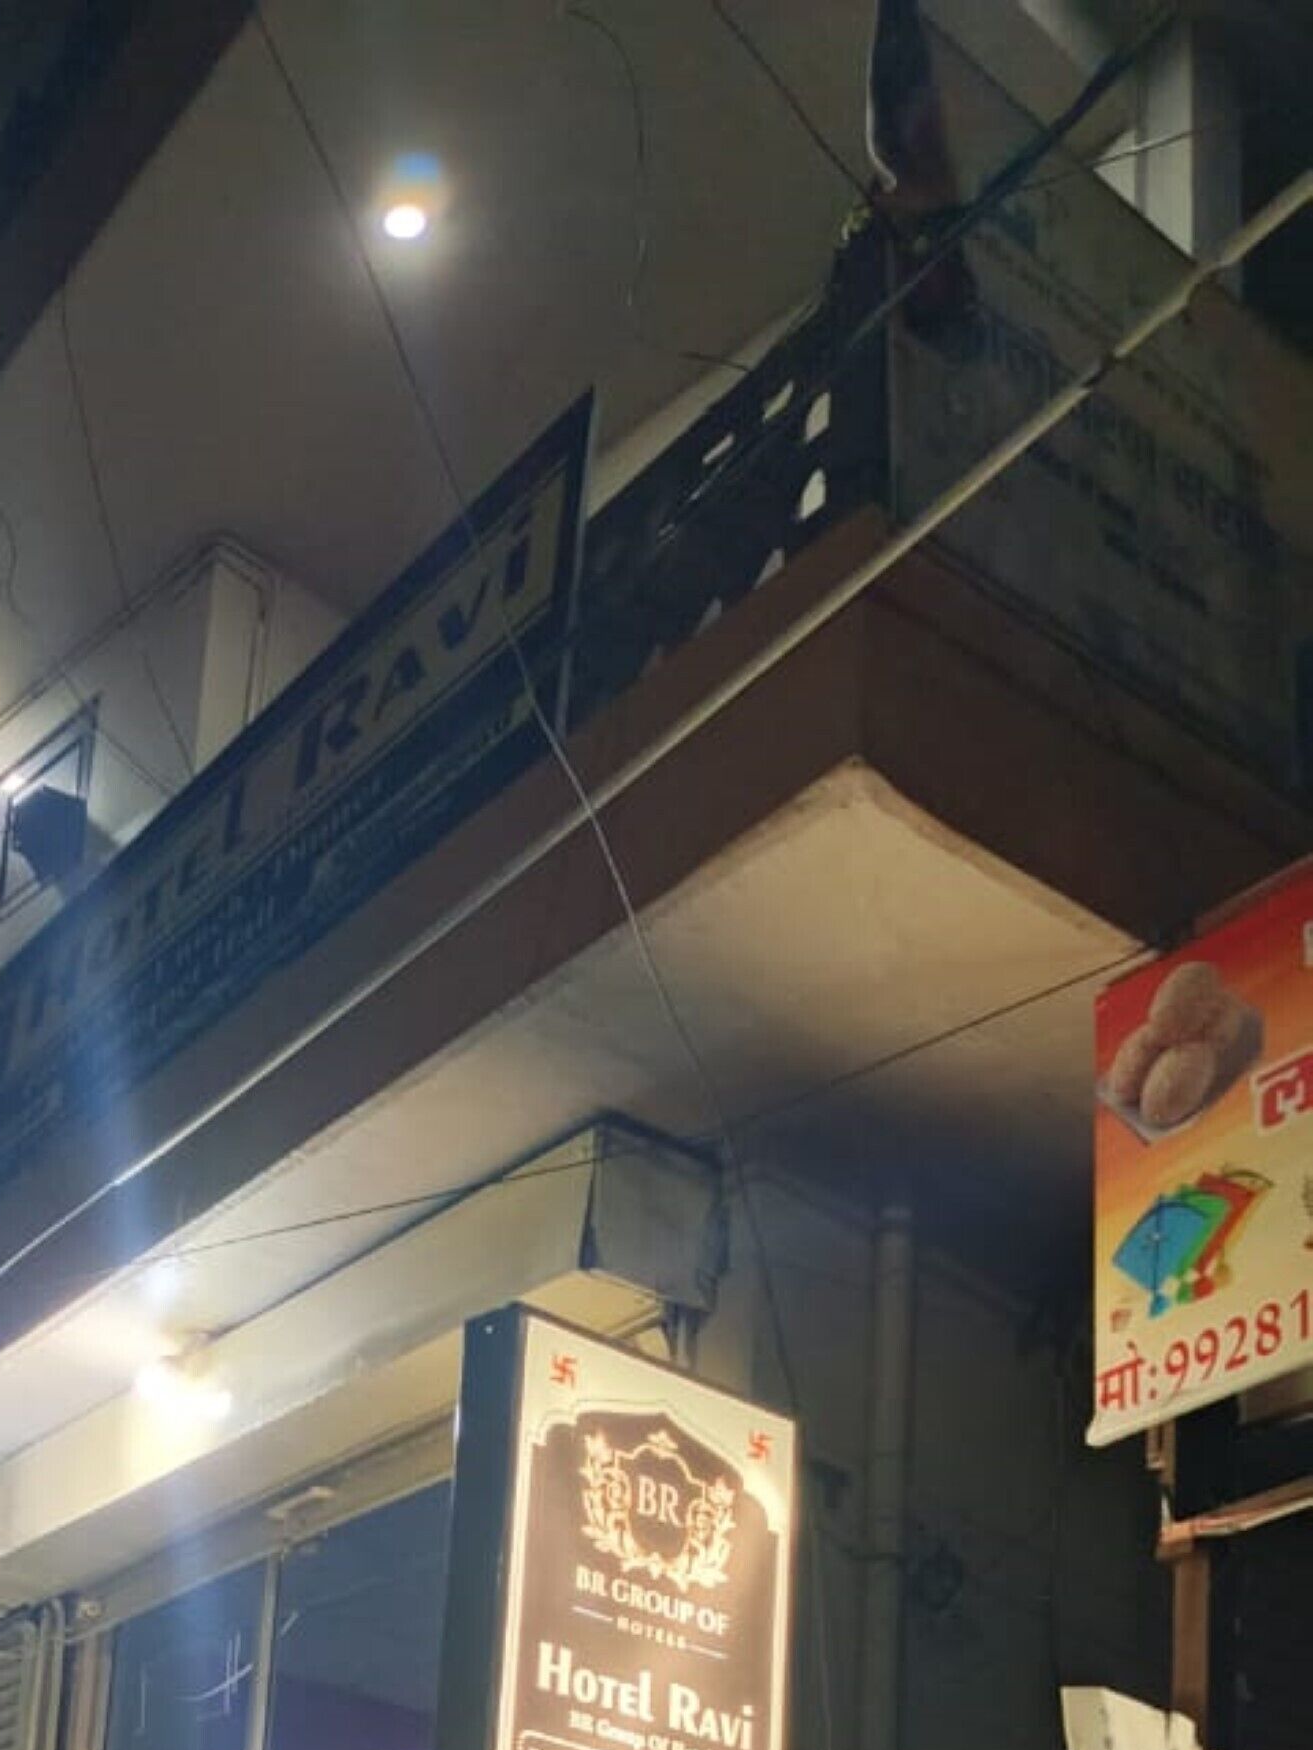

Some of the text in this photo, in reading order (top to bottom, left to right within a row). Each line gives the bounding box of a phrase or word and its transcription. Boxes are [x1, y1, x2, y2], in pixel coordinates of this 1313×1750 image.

[637, 1475, 682, 1528] BR
[575, 1565, 729, 1636] BR GROUP OF
[617, 1616, 688, 1647] HOTELS
